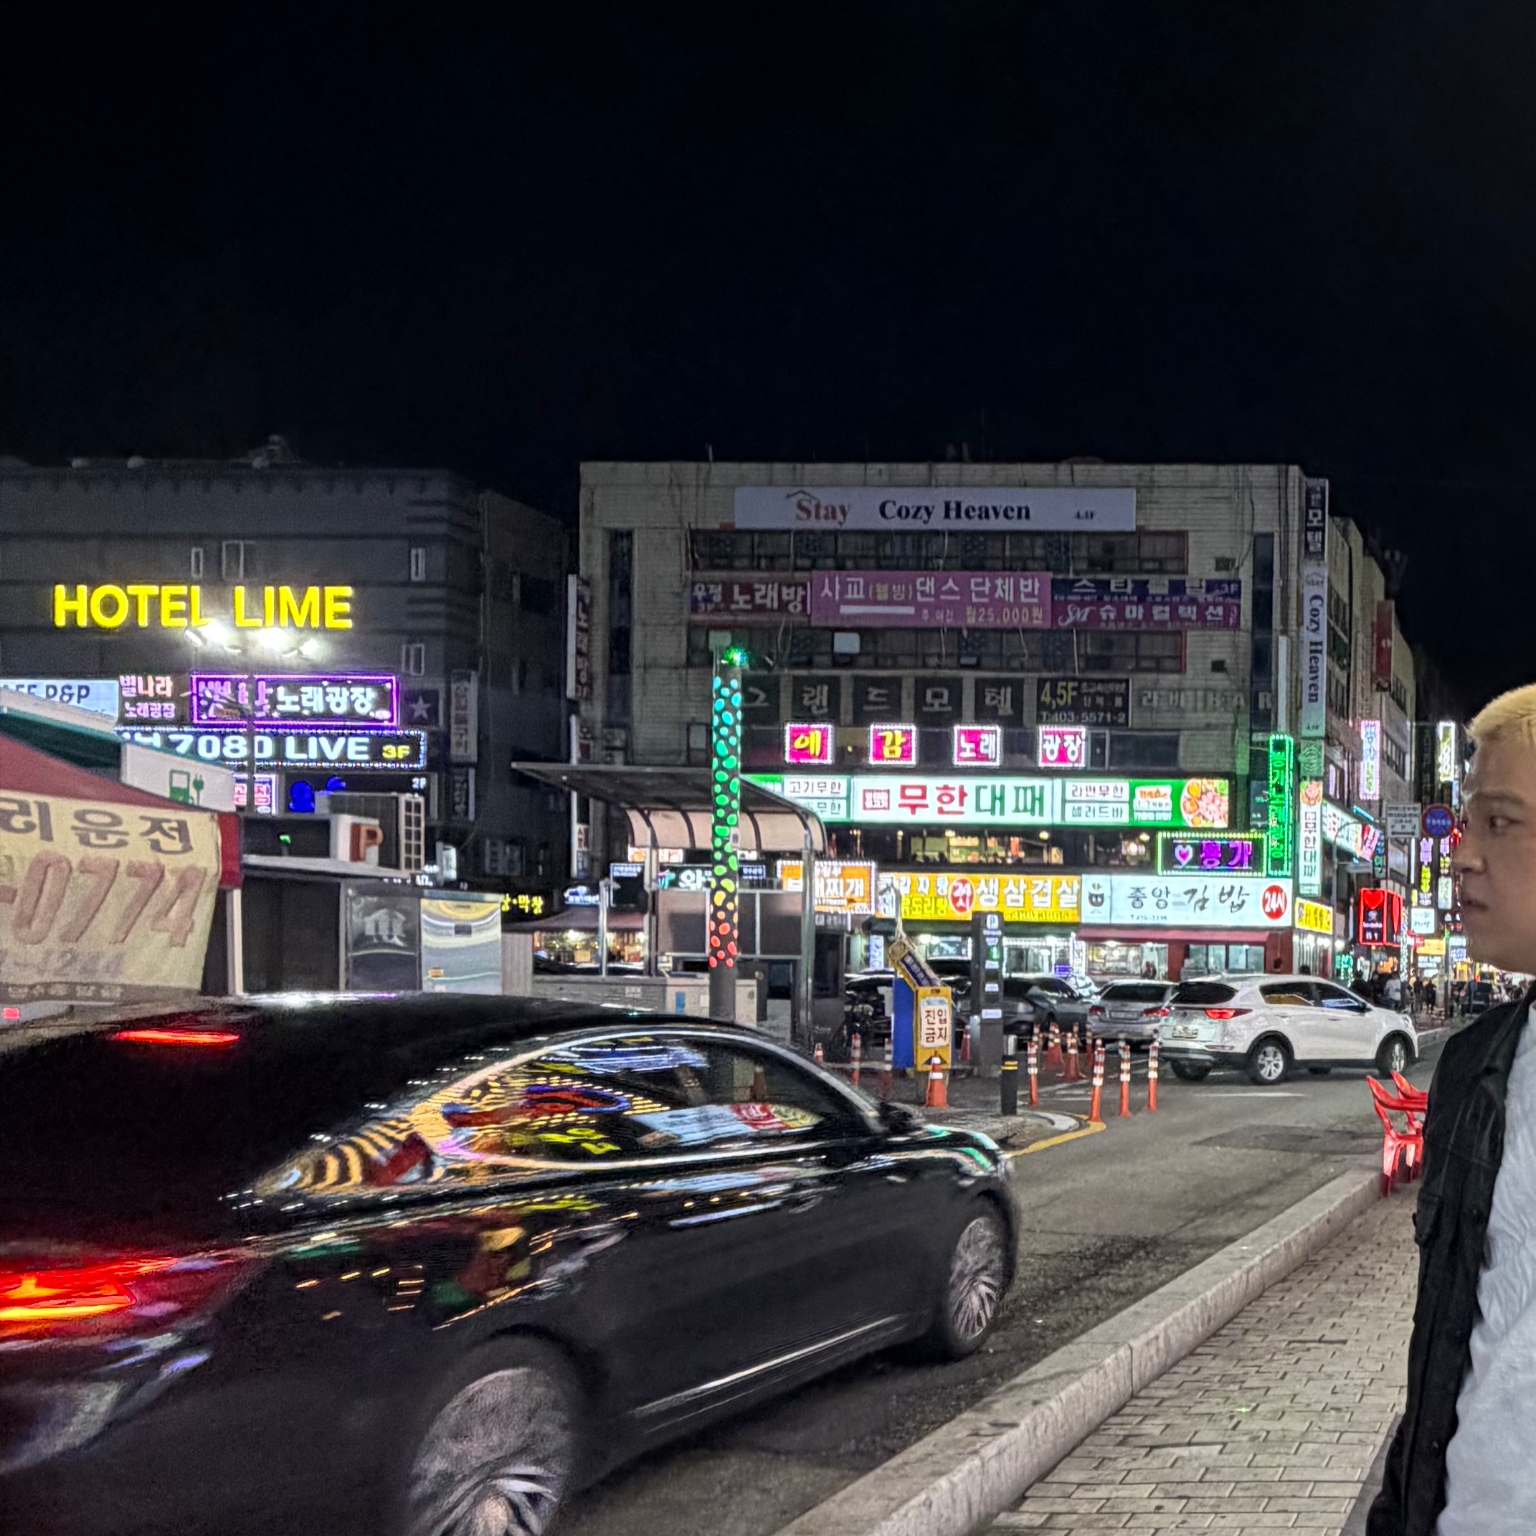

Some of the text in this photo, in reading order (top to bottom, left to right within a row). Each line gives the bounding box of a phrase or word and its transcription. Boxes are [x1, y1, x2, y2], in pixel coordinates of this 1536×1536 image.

[796, 499, 850, 526] Stay
[879, 500, 935, 524] Cozy
[943, 500, 1031, 521] Heaven
[54, 584, 353, 629] HOTEL LIME
[731, 583, 807, 614] 노래방
[119, 675, 173, 698] 별나라
[276, 684, 376, 715] 노래광장
[168, 734, 273, 760] 7080
[285, 736, 370, 760] LIVE
[382, 745, 410, 759] 3F
[898, 784, 1045, 817] 무한대패
[976, 877, 1080, 908] 생삼겹살
[1184, 884, 1250, 913] 김밥
[925, 1009, 947, 1025] 진입
[925, 1026, 947, 1043] 금지
